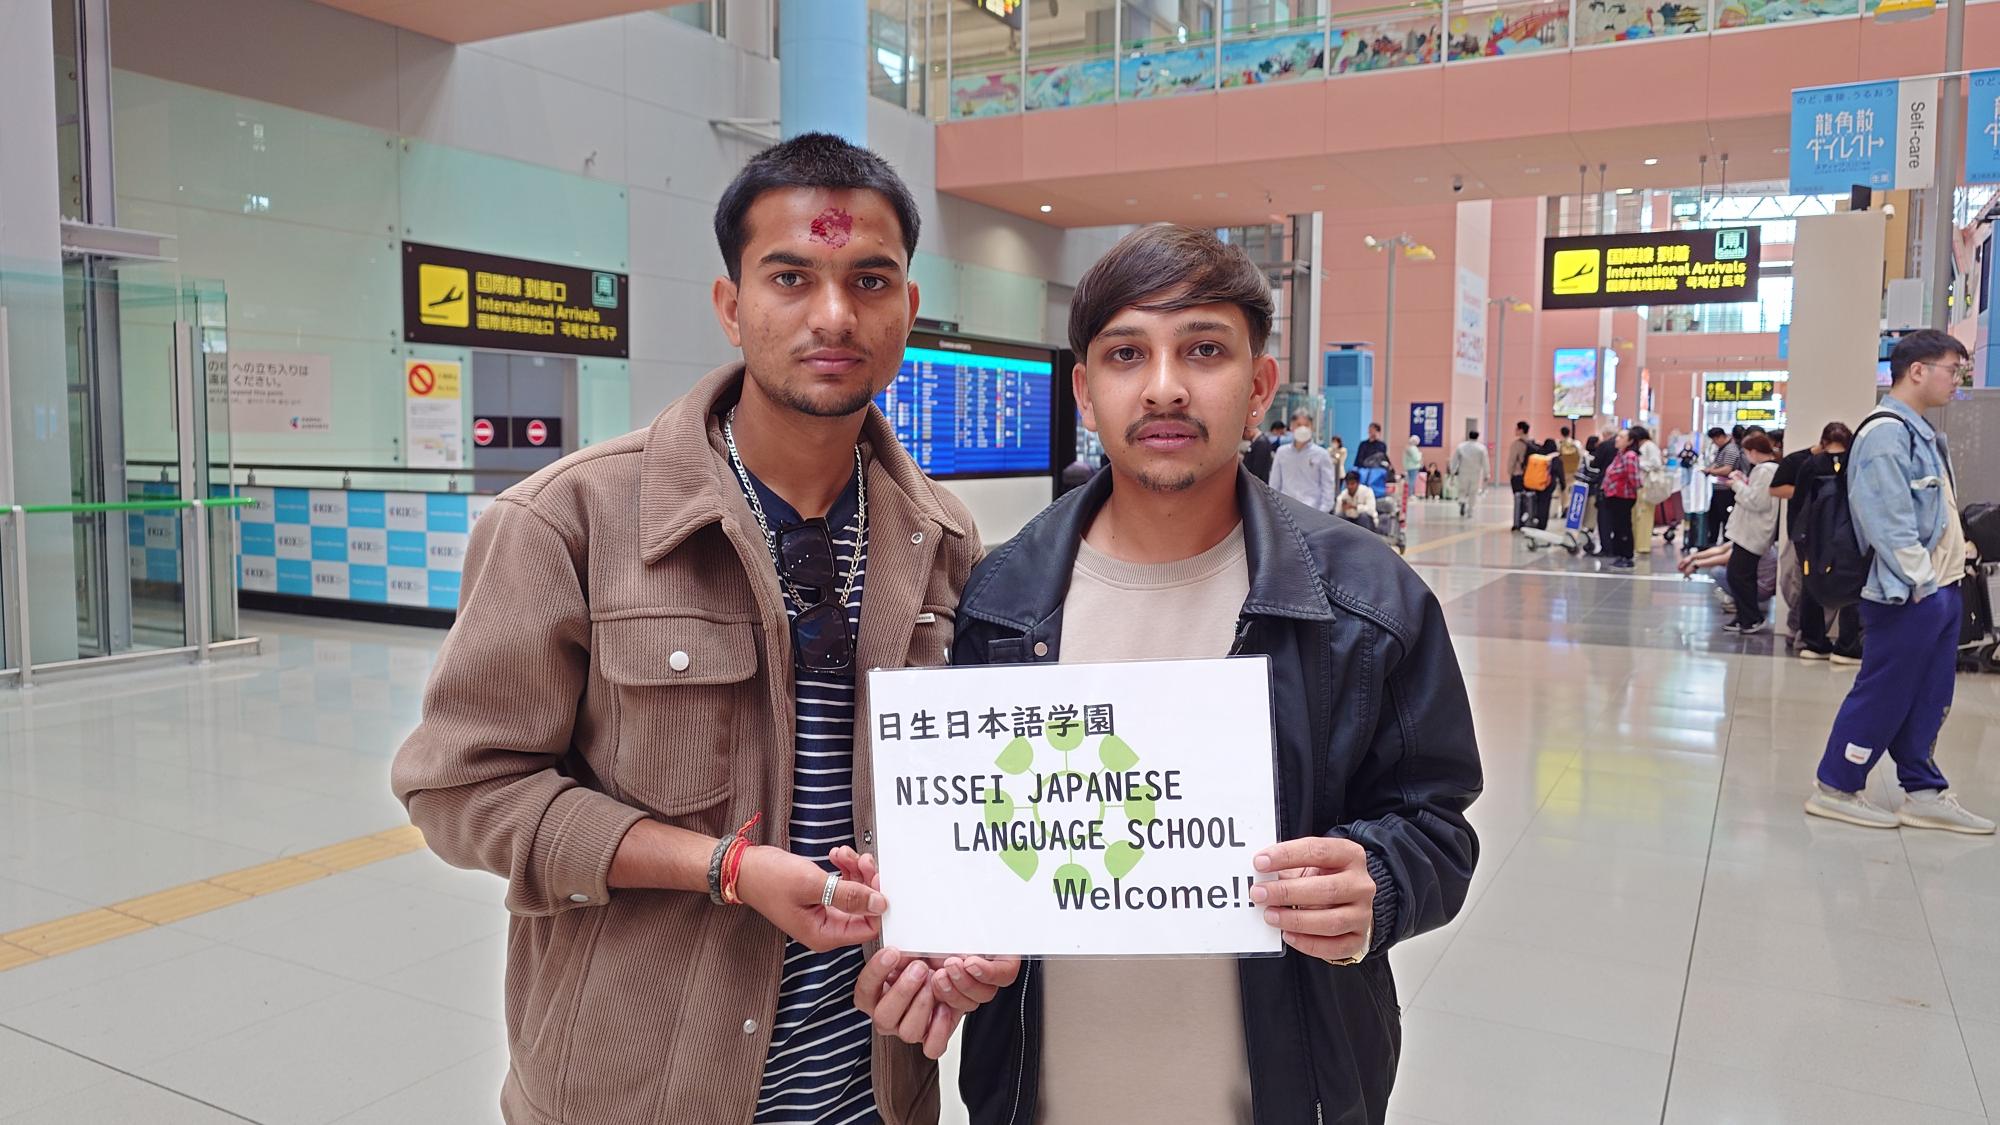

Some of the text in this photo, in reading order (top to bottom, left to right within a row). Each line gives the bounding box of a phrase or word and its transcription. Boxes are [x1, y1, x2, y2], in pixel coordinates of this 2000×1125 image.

[1815, 108, 1875, 138] 龍角散
[1908, 101, 1926, 169] Self-care
[1806, 132, 1885, 165] ダイレクト
[1606, 259, 1747, 280] International Arrivals
[476, 295, 600, 324] International Arrivals
[879, 703, 1115, 741] 日生日本語学園
[896, 770, 1183, 806] NISSEI JAPANESE
[953, 816, 1246, 852] LANGUAGE SCHOOL
[1053, 875, 1255, 911] Welcome!!
